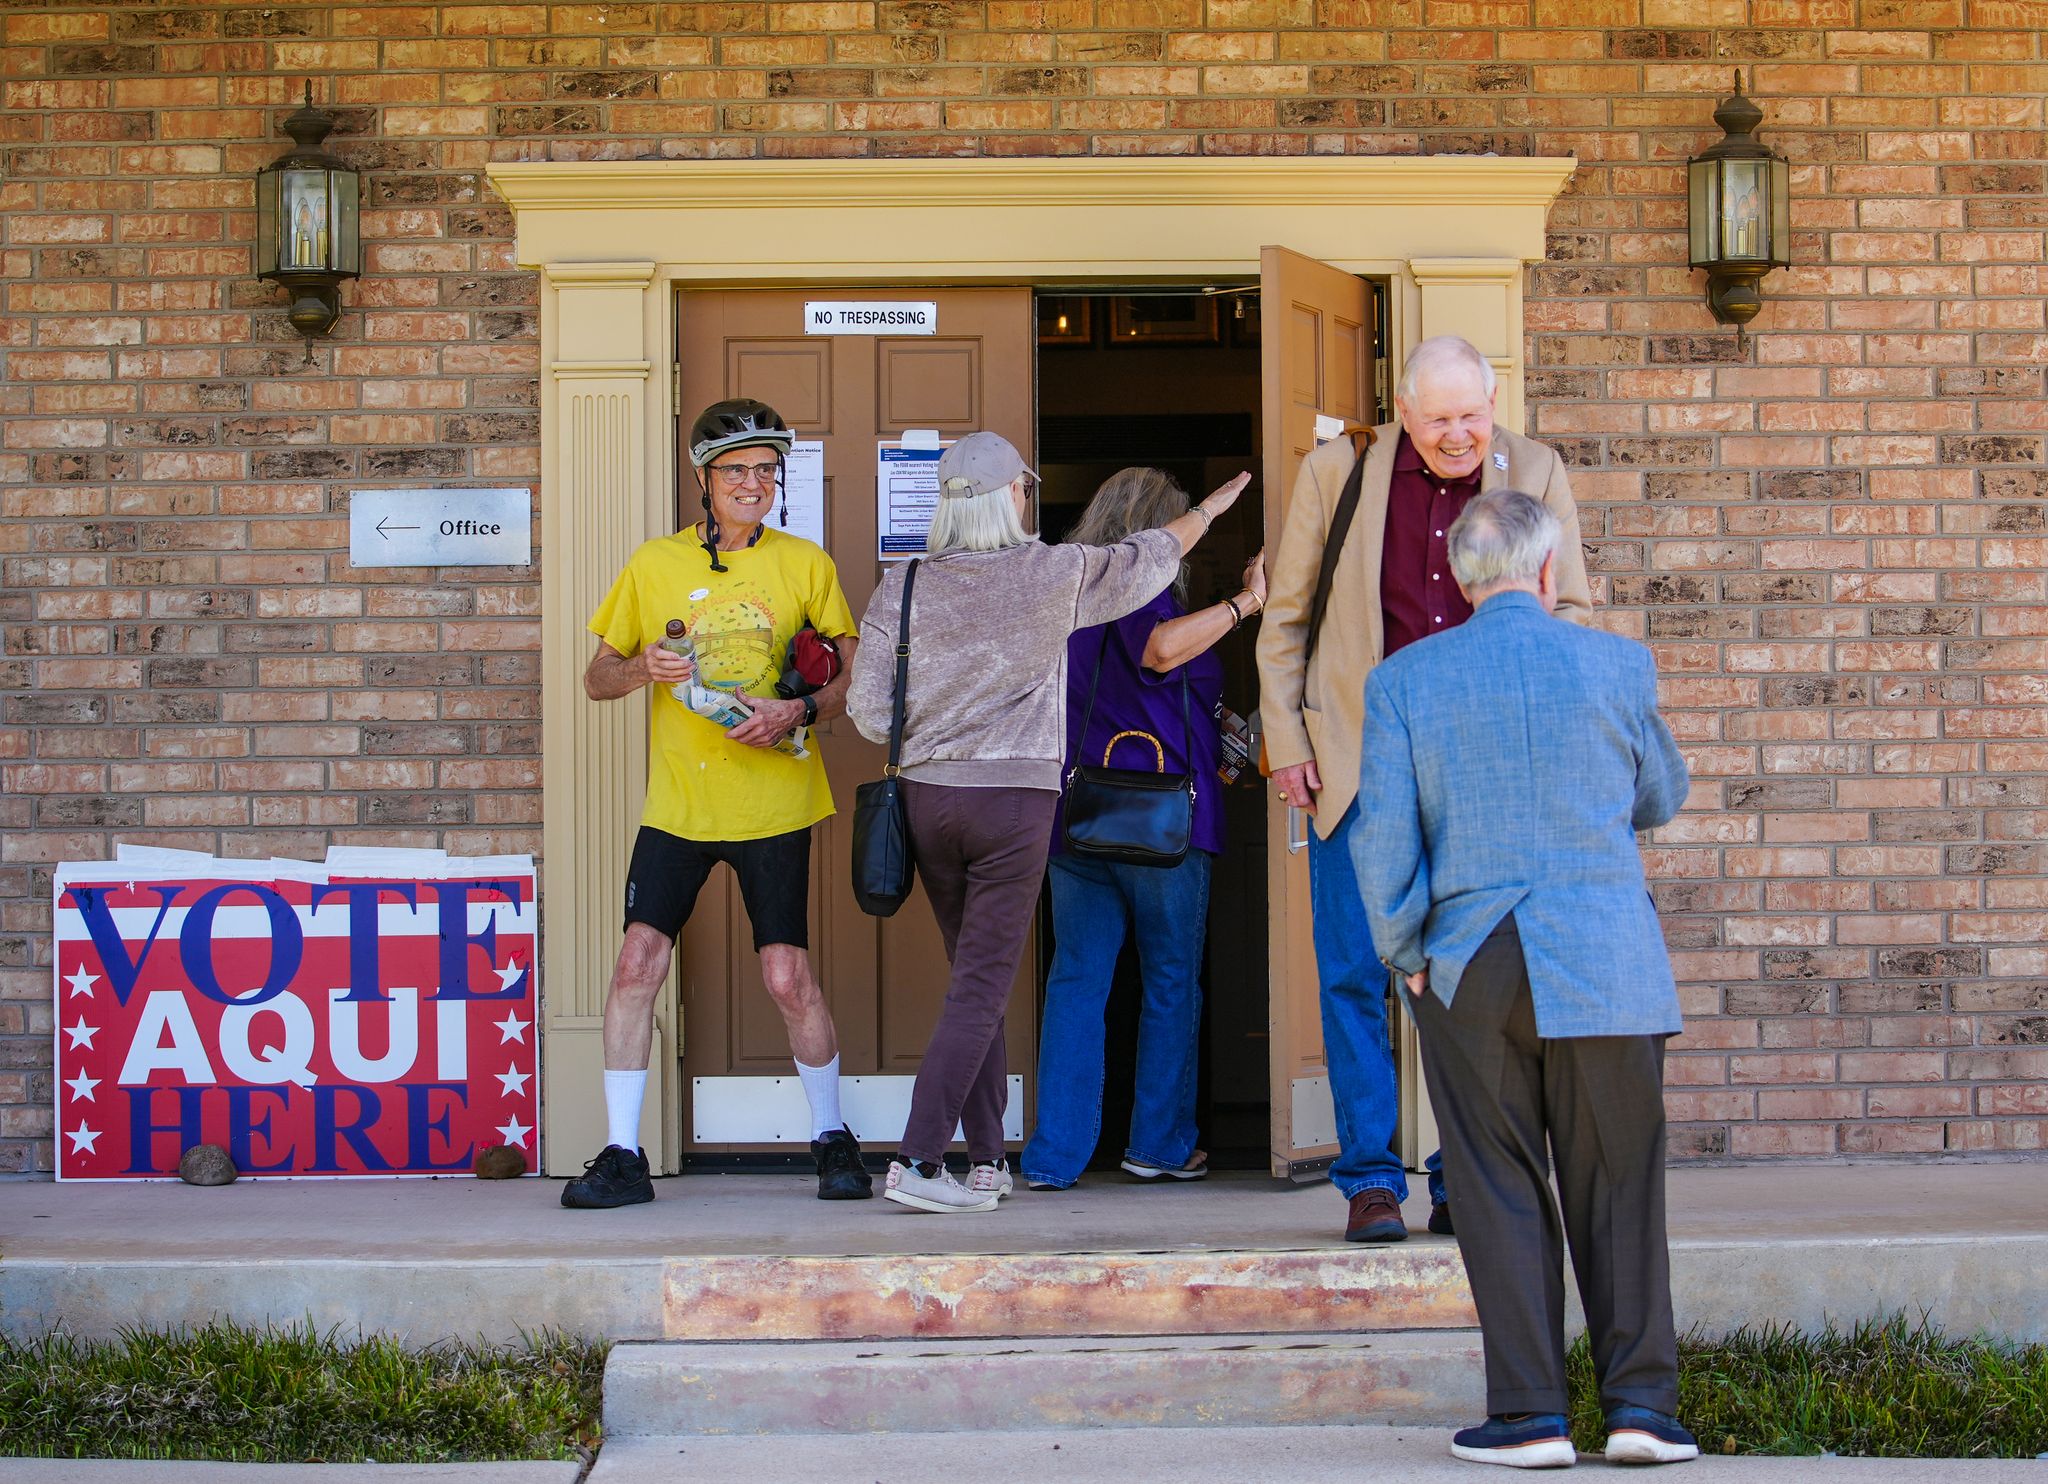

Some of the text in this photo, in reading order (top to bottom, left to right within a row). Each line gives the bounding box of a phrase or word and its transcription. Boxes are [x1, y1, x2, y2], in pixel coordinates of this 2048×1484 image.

[815, 311, 926, 324] NO TRESPASSING
[440, 520, 501, 536] Office
[750, 595, 777, 627] Books
[63, 880, 530, 1007] VOTE
[117, 986, 468, 1092] AQUI
[117, 1082, 475, 1175] HERE
